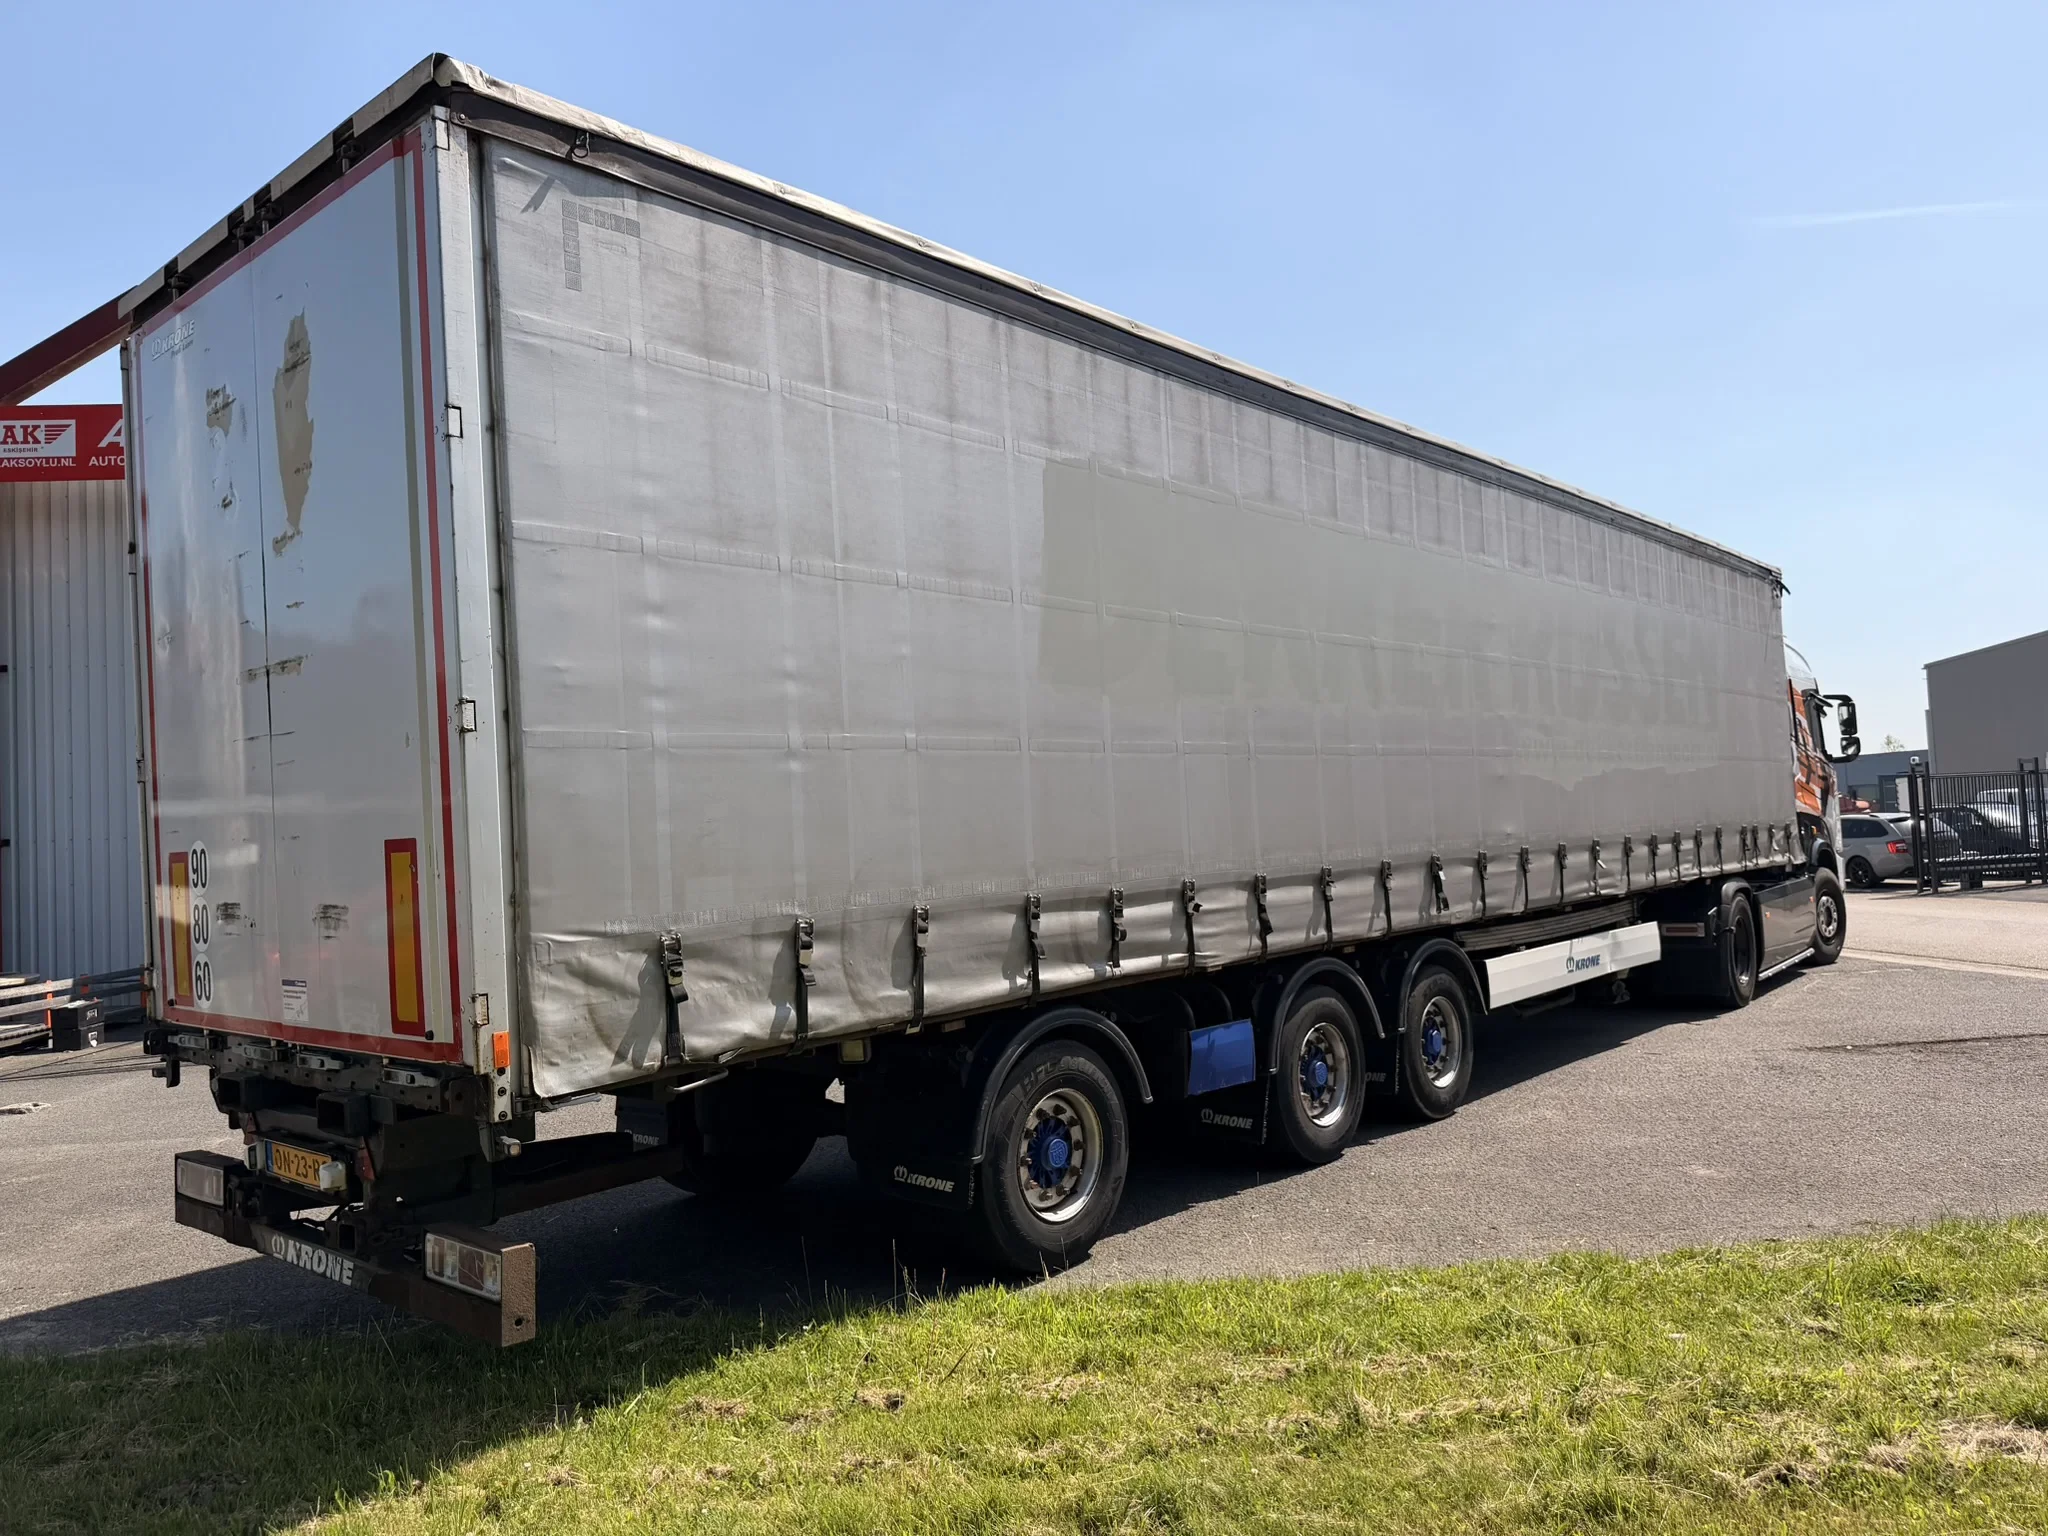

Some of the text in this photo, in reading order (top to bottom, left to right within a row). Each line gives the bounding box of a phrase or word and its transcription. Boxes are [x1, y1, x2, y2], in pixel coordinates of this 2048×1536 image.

[161, 320, 195, 353] KRONE
[191, 848, 207, 888] 90
[193, 904, 209, 944] 80
[1575, 954, 1601, 972] KRONE
[195, 960, 211, 1002] 60
[1213, 1113, 1254, 1129] KRONE
[632, 1133, 660, 1146] KRONE
[275, 1148, 327, 1182] ON-23-R
[907, 1173, 955, 1193] KRONE
[286, 1239, 354, 1286] KRONE
